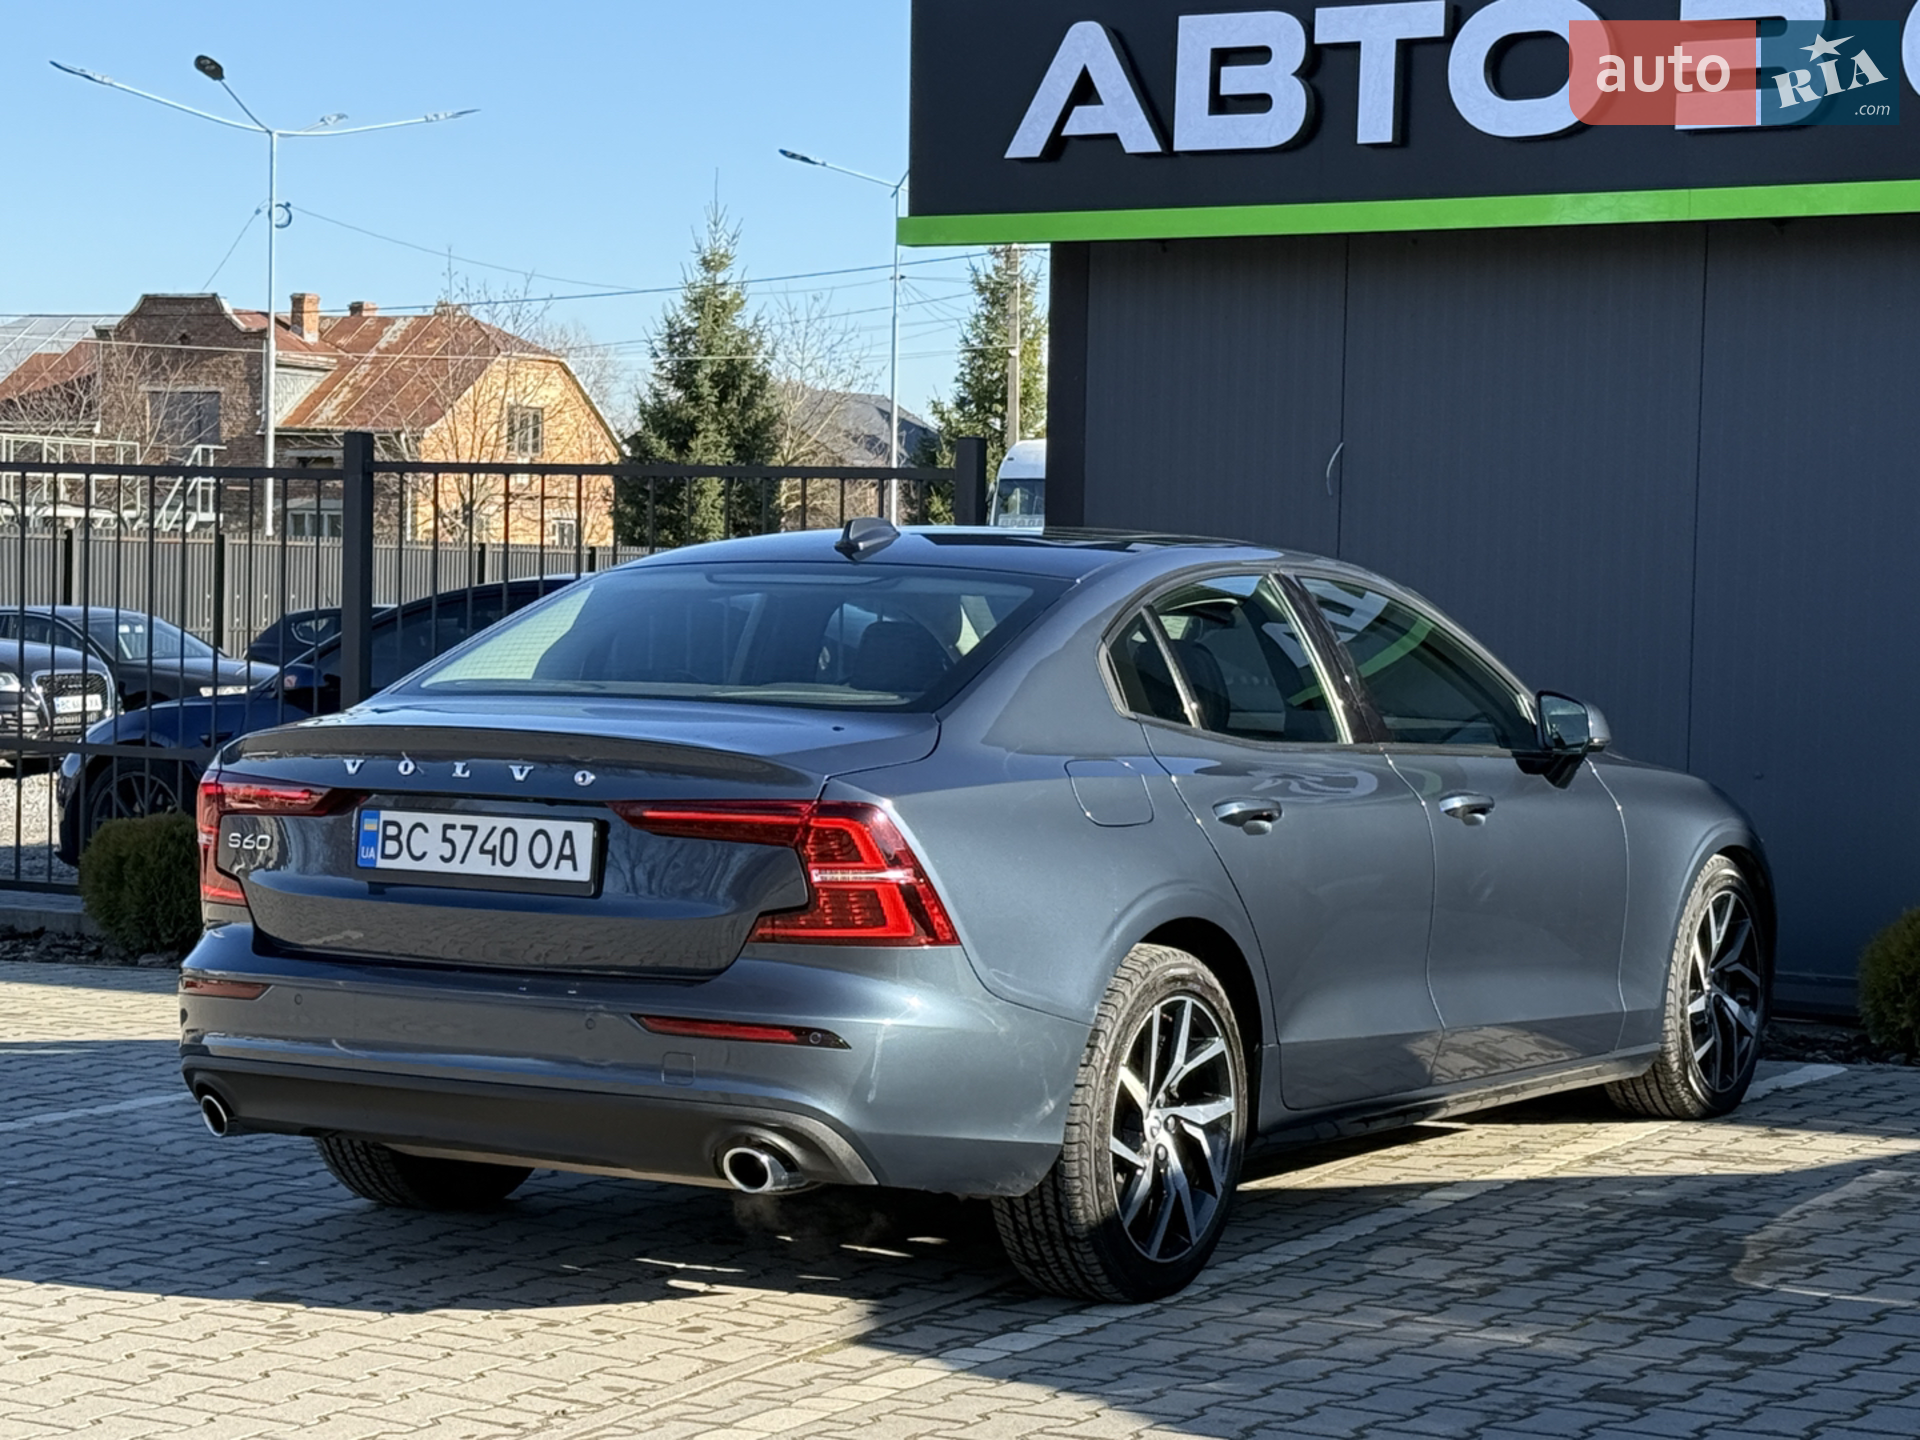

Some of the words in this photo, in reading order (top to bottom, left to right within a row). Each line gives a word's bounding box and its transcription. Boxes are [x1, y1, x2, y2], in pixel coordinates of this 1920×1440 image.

[1004, 0, 1611, 160] АВТО
[343, 758, 597, 787] VOLVO
[228, 832, 271, 851] S60
[361, 846, 376, 860] UA
[380, 820, 430, 862] BC
[439, 823, 518, 868] 5740
[528, 828, 578, 872] OA
